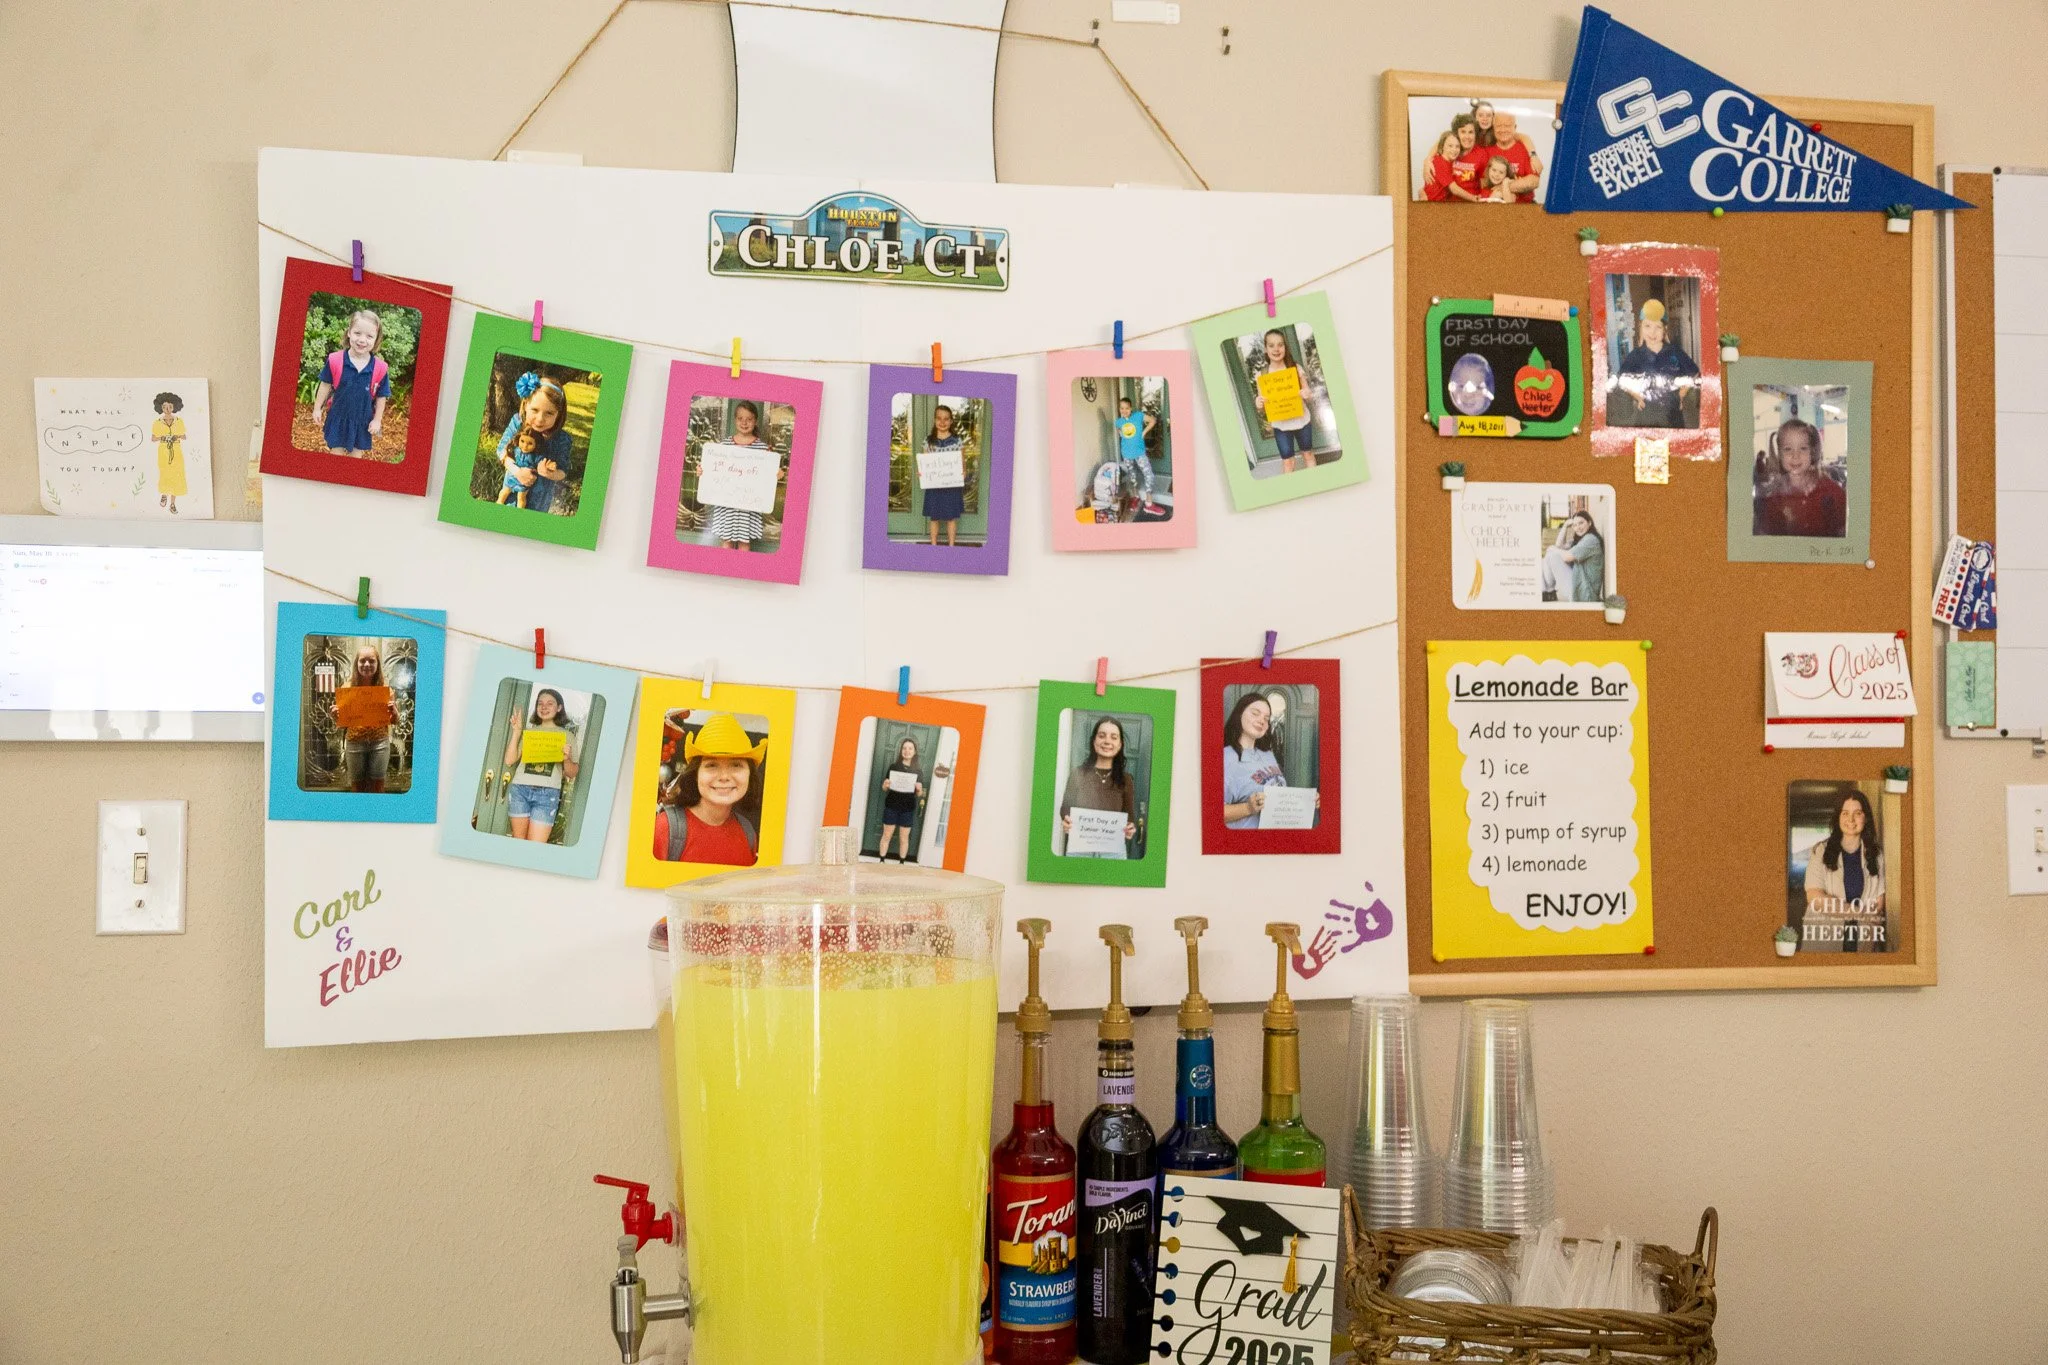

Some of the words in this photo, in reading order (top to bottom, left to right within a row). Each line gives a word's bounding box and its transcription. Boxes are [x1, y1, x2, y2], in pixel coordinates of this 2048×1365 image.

[1597, 76, 1701, 149] GC
[1702, 89, 1857, 180] GARRETT
[1600, 151, 1664, 200] EXCEL!
[1689, 147, 1853, 204] COLLEGE
[827, 206, 898, 222] HOUSTON
[846, 219, 881, 229] TEXAS
[737, 224, 904, 275] CHLOE
[923, 234, 985, 279] CT
[1445, 319, 1496, 331] FIRST
[1498, 318, 1530, 330] DAY
[1443, 334, 1467, 347] OF
[1470, 333, 1534, 346] SCHOOL
[1458, 421, 1475, 433] Aug
[1461, 502, 1494, 513] GRAD
[1499, 503, 1536, 513] PARTY
[1470, 525, 1512, 537] CHLOE
[1476, 536, 1521, 548] HEETER
[1935, 588, 1951, 617] FREE
[1454, 673, 1580, 698] Lemonade
[1590, 676, 1629, 697] Bar
[1859, 681, 1908, 700] 2025
[1469, 721, 1506, 739] Add
[1515, 722, 1532, 738] to
[1538, 724, 1580, 744] your
[1586, 724, 1624, 743] cup:
[1480, 758, 1495, 779] 1)
[1503, 758, 1530, 776] ice
[1480, 790, 1500, 811] 2)
[1505, 790, 1548, 808] fruit
[1480, 823, 1500, 843] 3)
[1505, 826, 1551, 845] pump
[1556, 821, 1575, 840] of
[1581, 824, 1628, 843] syrup
[1481, 855, 1500, 876] 4)
[1506, 854, 1588, 873] lemonade
[293, 869, 382, 940] Carl
[1525, 891, 1628, 918] ENJOY!
[1811, 897, 1879, 915] CHLOE
[335, 926, 354, 953] &
[1802, 925, 1887, 942] HEETER
[319, 947, 402, 1008] Ellie
[1095, 1202, 1149, 1235] DaVinci
[1093, 1268, 1103, 1318] LAVENDER
[1176, 1259, 1328, 1365] Grad
[1224, 1336, 1315, 1365] 2025
